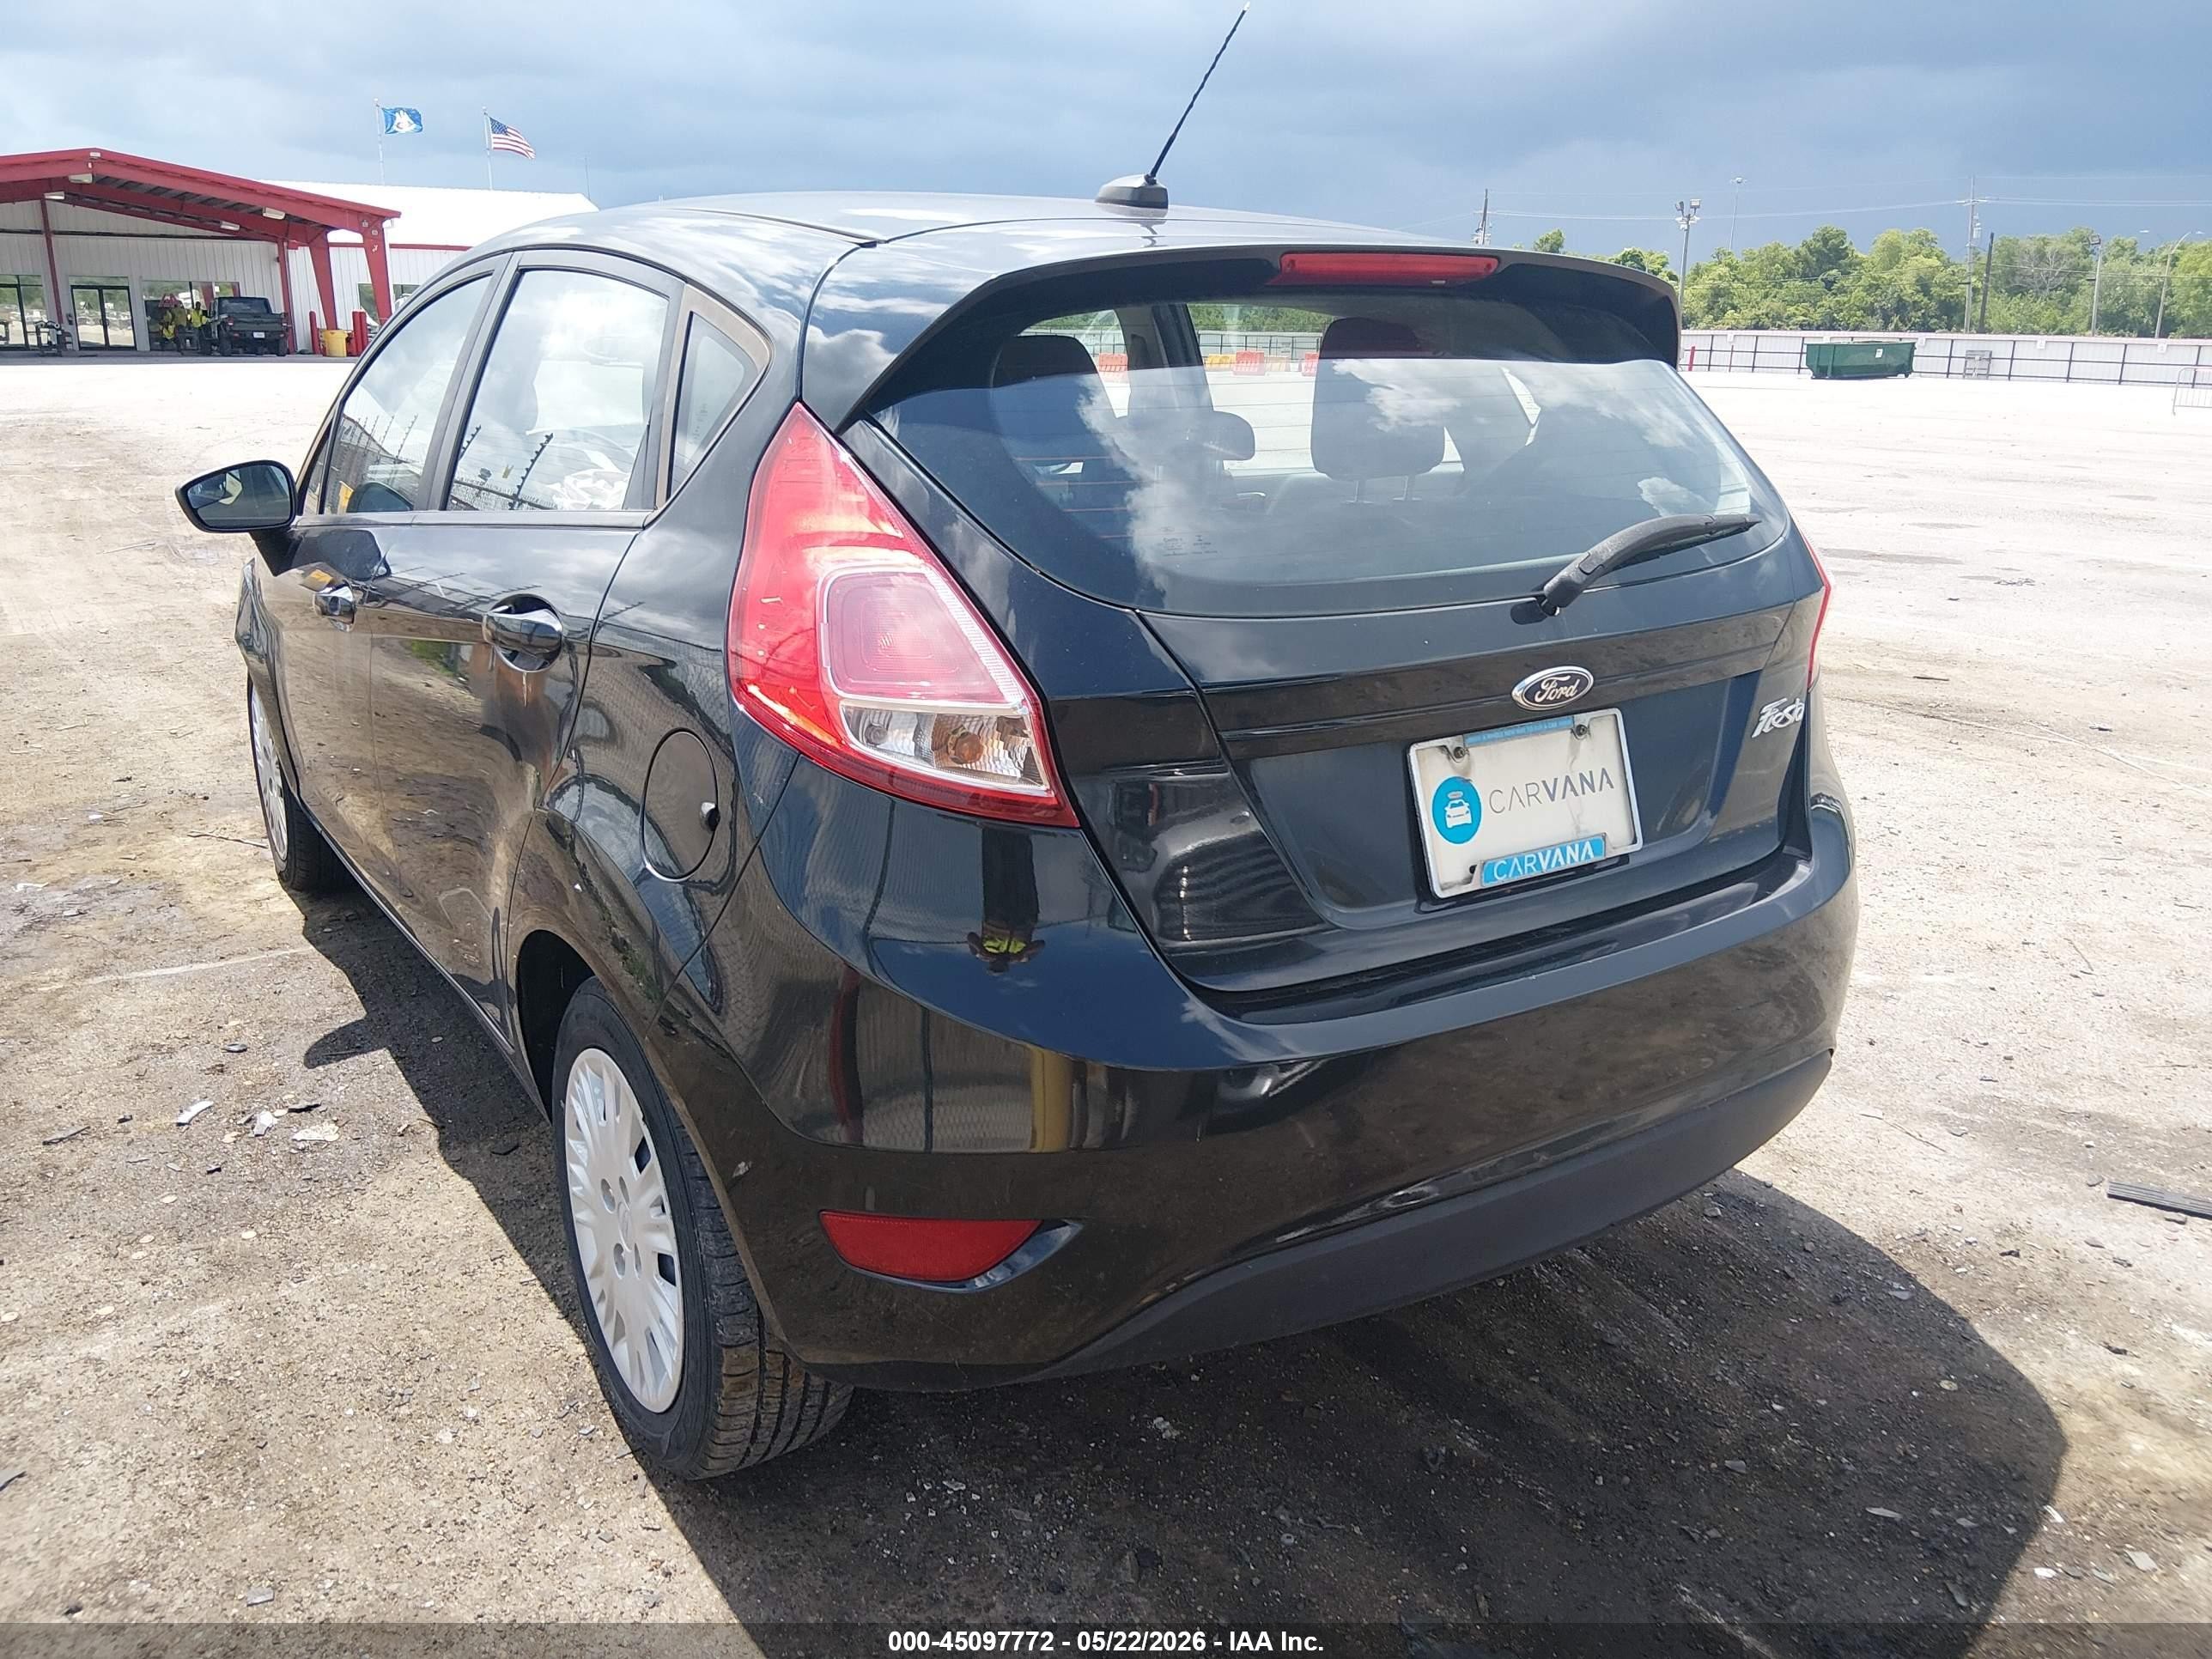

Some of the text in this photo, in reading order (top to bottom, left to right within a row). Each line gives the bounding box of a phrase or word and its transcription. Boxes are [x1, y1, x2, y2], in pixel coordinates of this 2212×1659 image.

[1534, 675, 1580, 702] Ford
[1489, 767, 1614, 814] CARVANA
[1493, 841, 1595, 880] CARVANA
